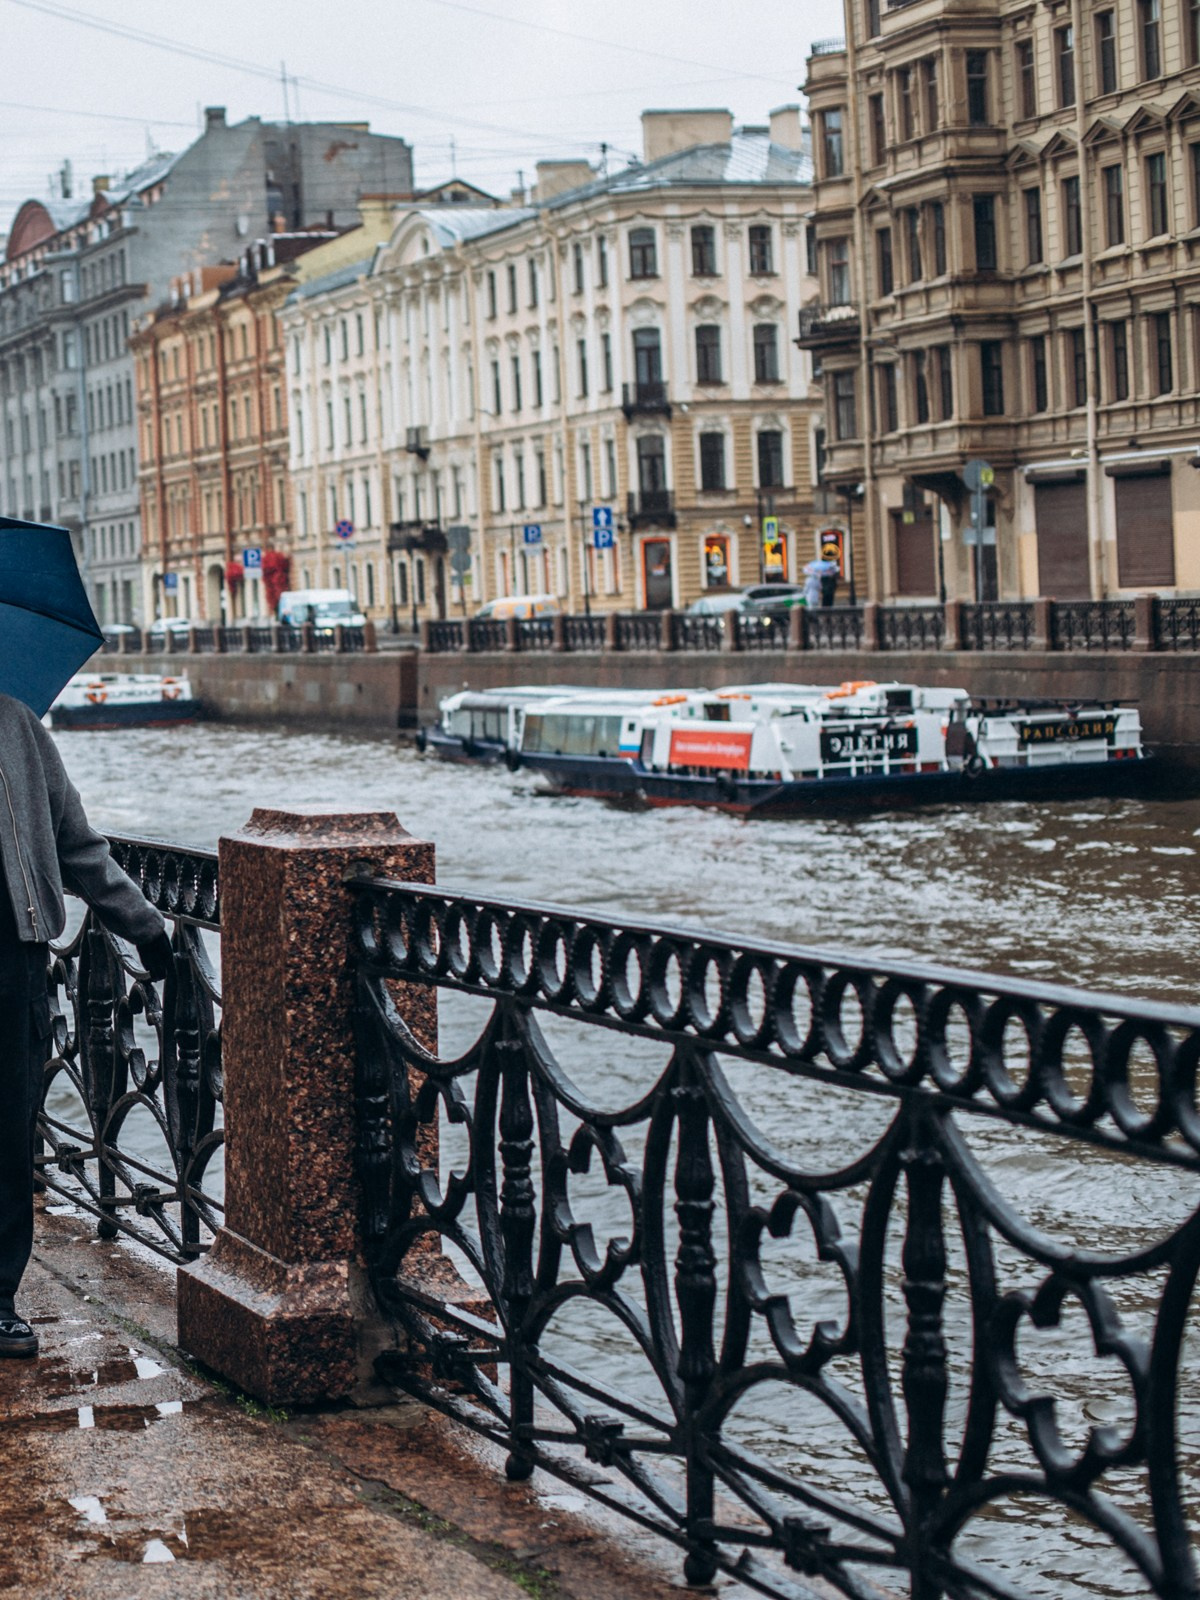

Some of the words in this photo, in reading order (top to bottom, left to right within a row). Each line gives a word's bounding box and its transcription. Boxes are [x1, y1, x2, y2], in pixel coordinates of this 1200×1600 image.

[598, 530, 610, 547] P
[247, 549, 259, 565] P
[1023, 722, 1114, 741] РАПСОДИЯ
[830, 733, 909, 754] ЭЛЕГИЯ
